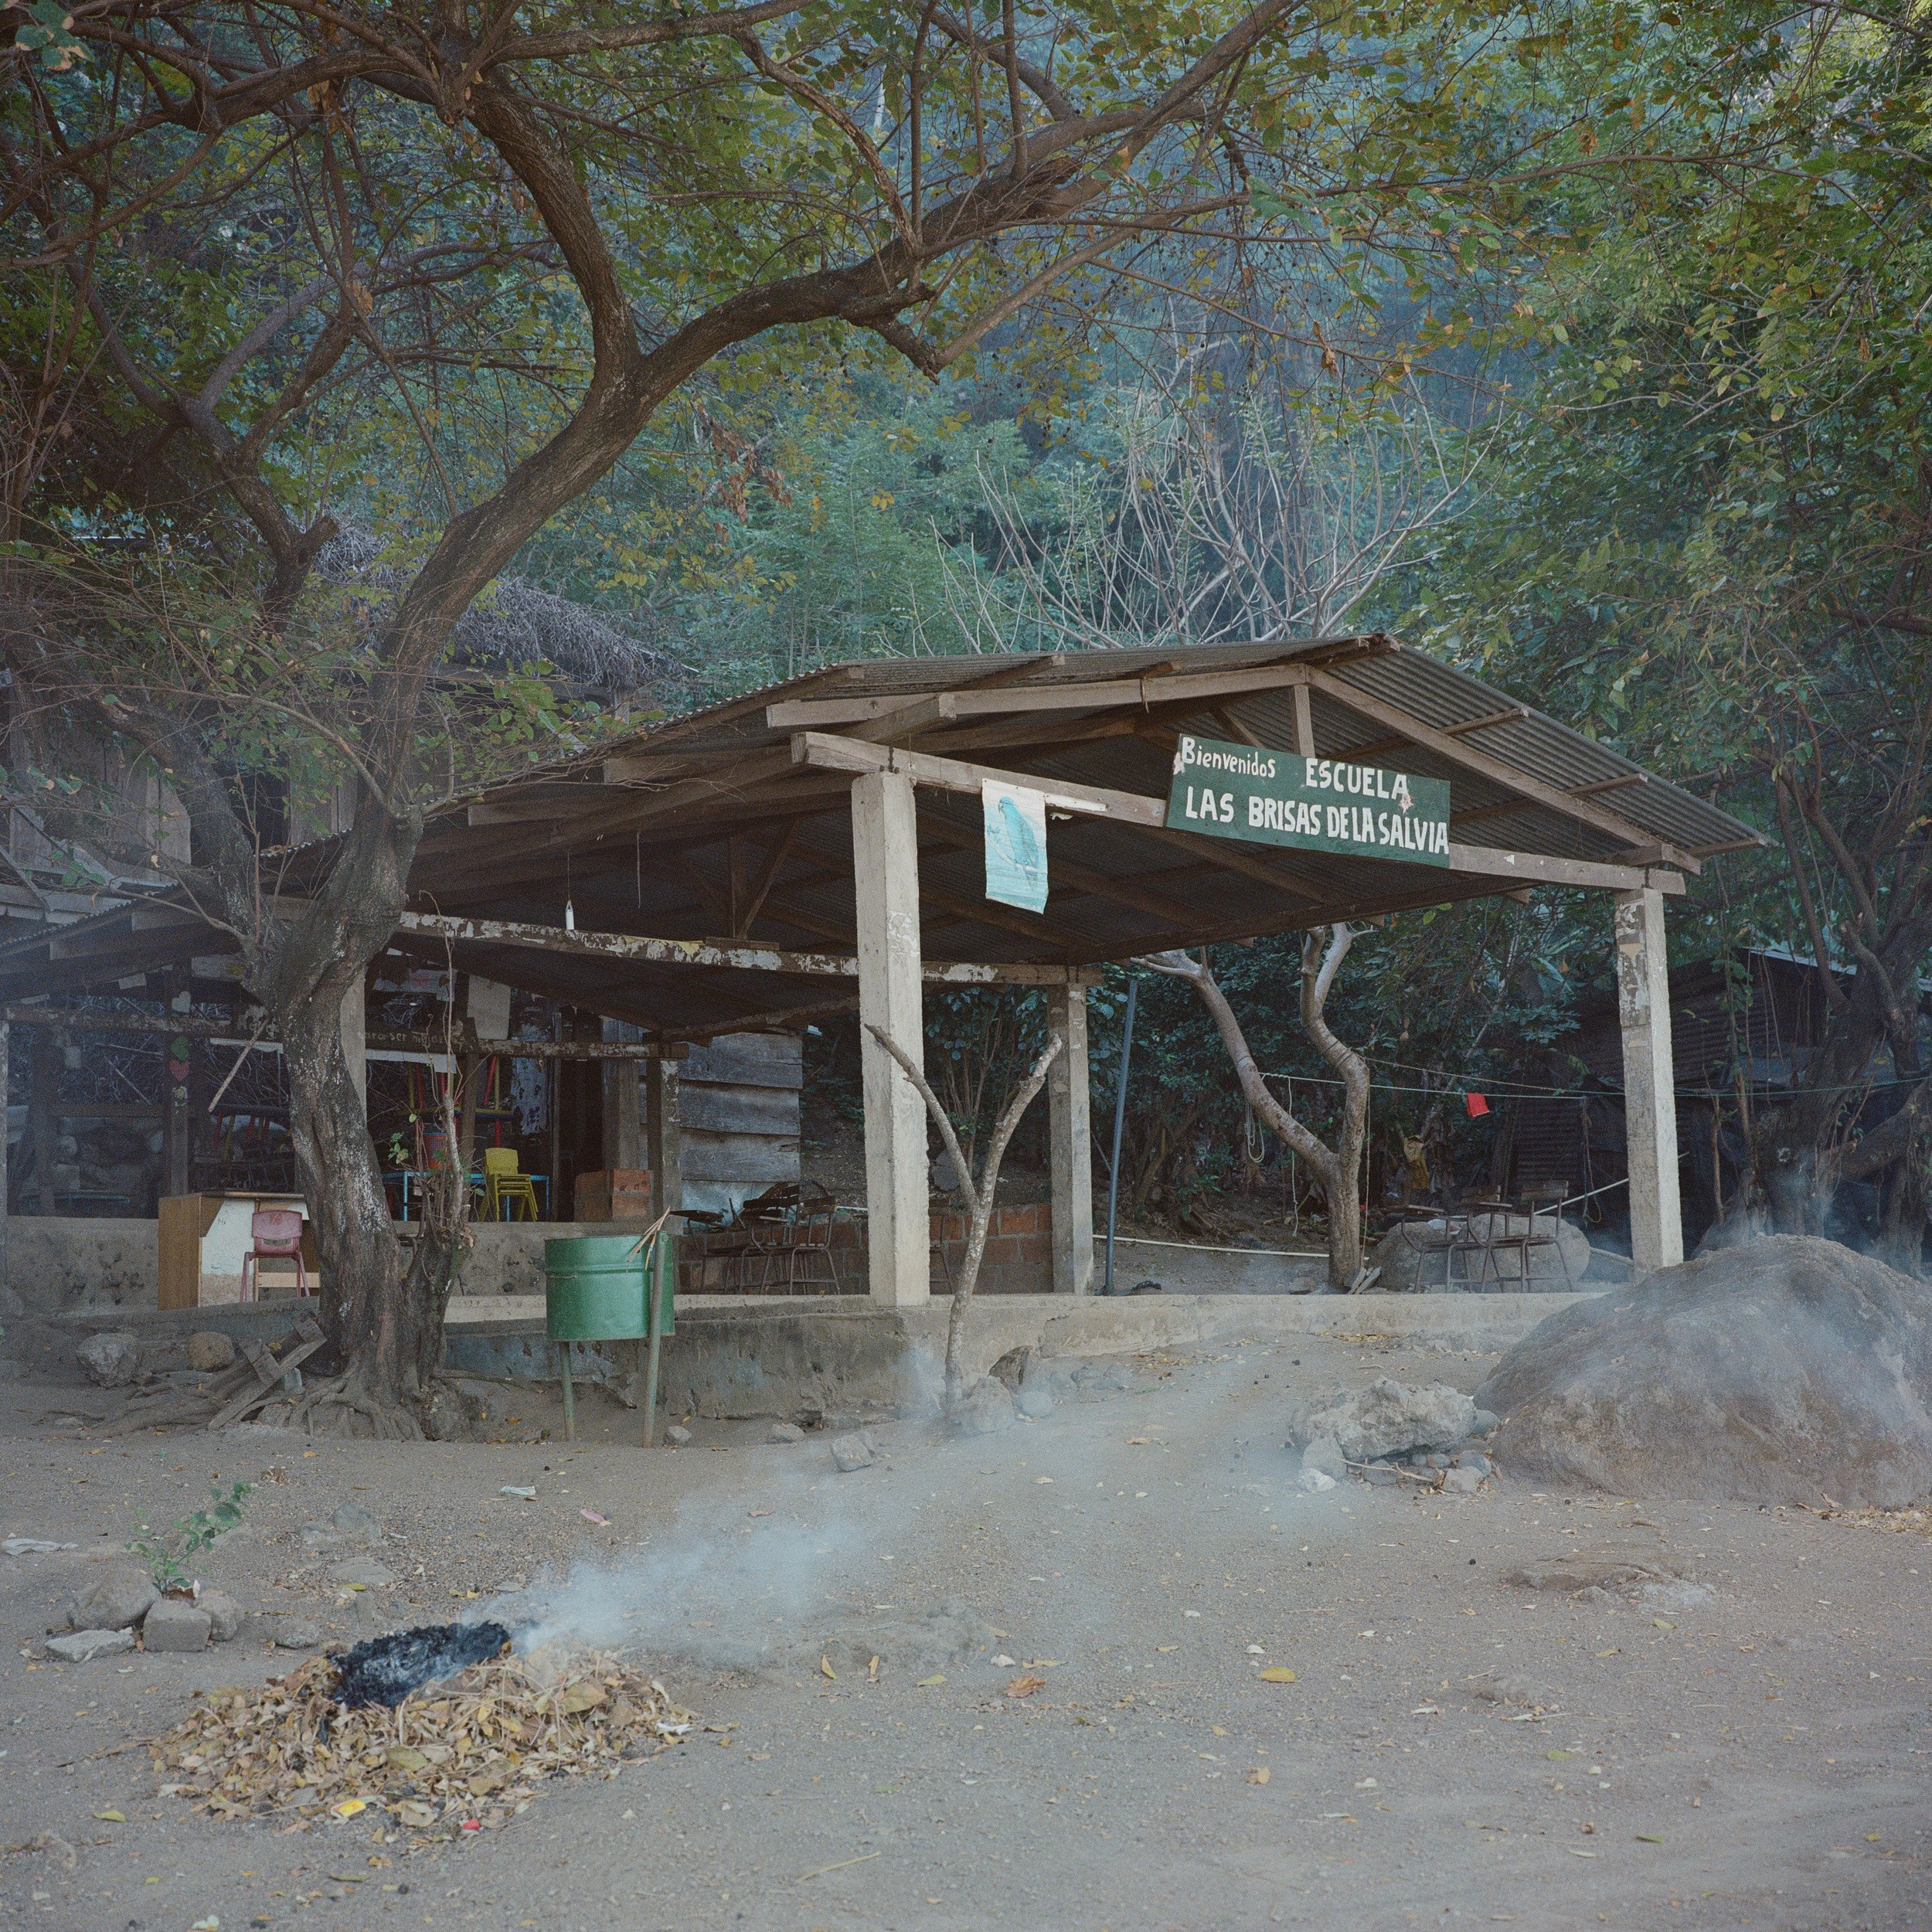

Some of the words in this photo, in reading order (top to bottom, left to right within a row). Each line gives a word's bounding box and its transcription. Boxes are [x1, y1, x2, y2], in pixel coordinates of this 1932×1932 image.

[1181, 736, 1276, 778] Bienvenidos
[1305, 758, 1409, 800] ESCUELA
[1185, 786, 1234, 822] LAS
[1248, 796, 1321, 835] BRISAS
[1379, 812, 1450, 855] SALVIA
